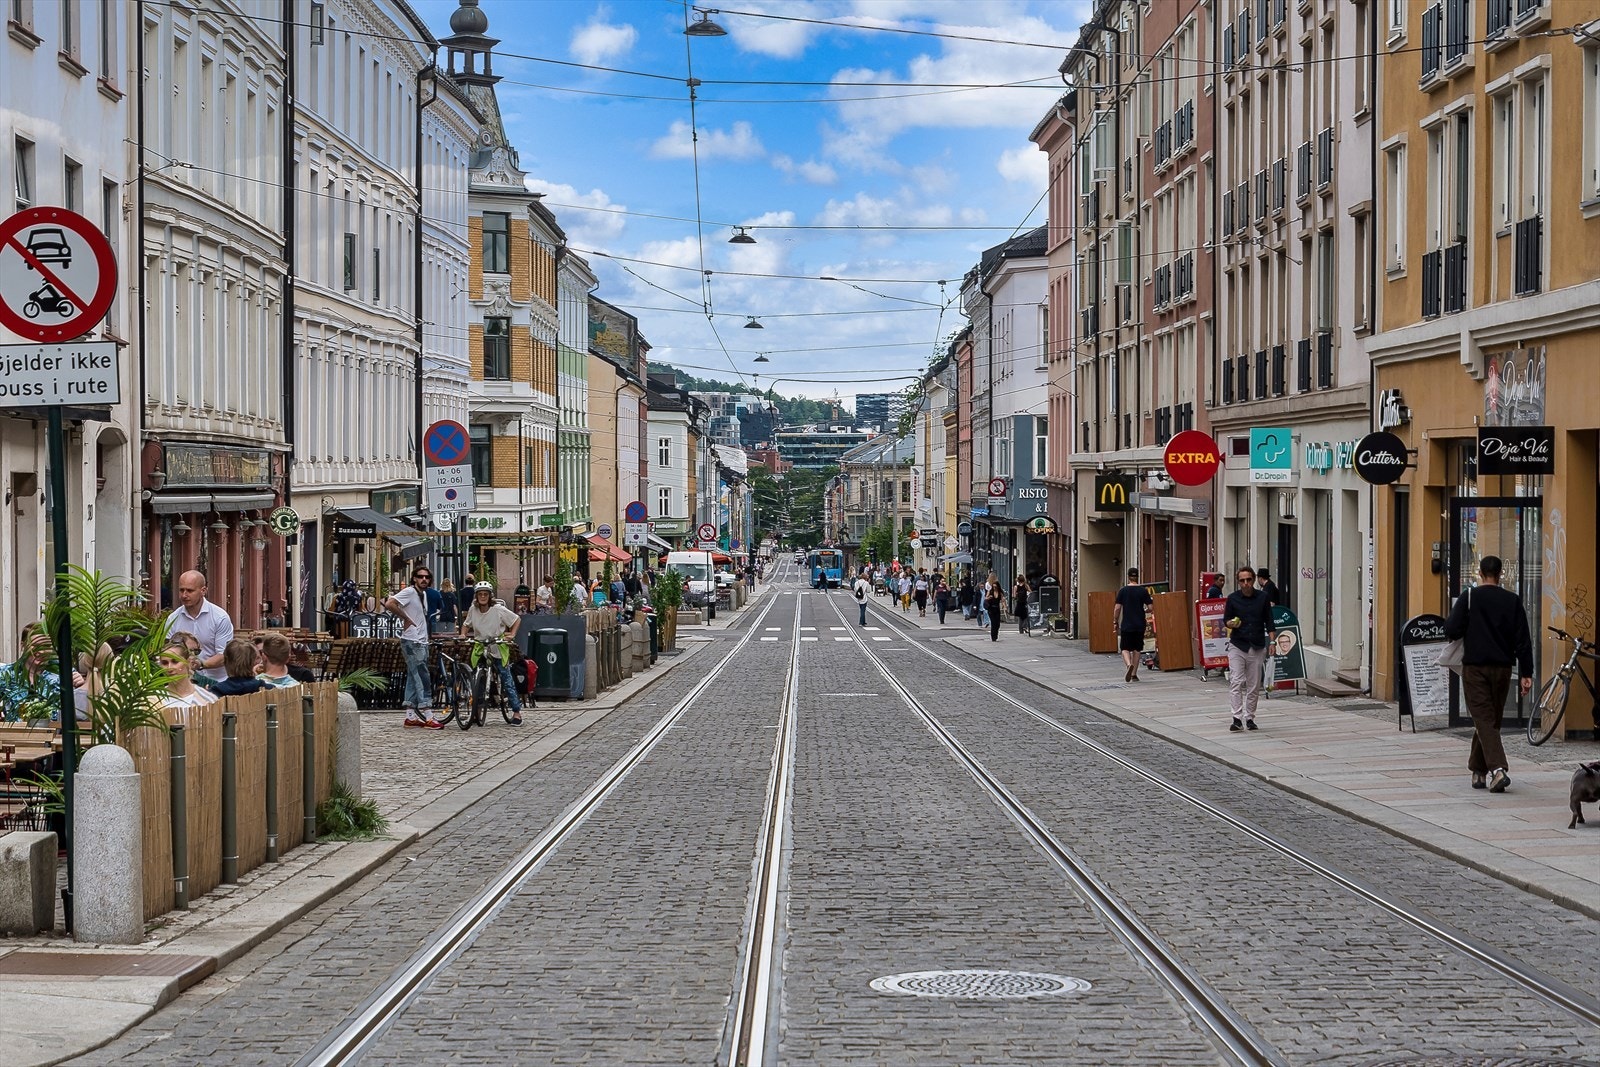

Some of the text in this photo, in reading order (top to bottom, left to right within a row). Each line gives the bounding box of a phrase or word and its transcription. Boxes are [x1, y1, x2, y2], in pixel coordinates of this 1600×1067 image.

[71, 352, 111, 369] ikke
[53, 378, 57, 394] i
[68, 377, 107, 394] rute
[1168, 453, 1216, 464] EXTRA
[1019, 488, 1048, 499] RISTO
[1035, 503, 1042, 512] &
[1200, 605, 1213, 613] Gjør
